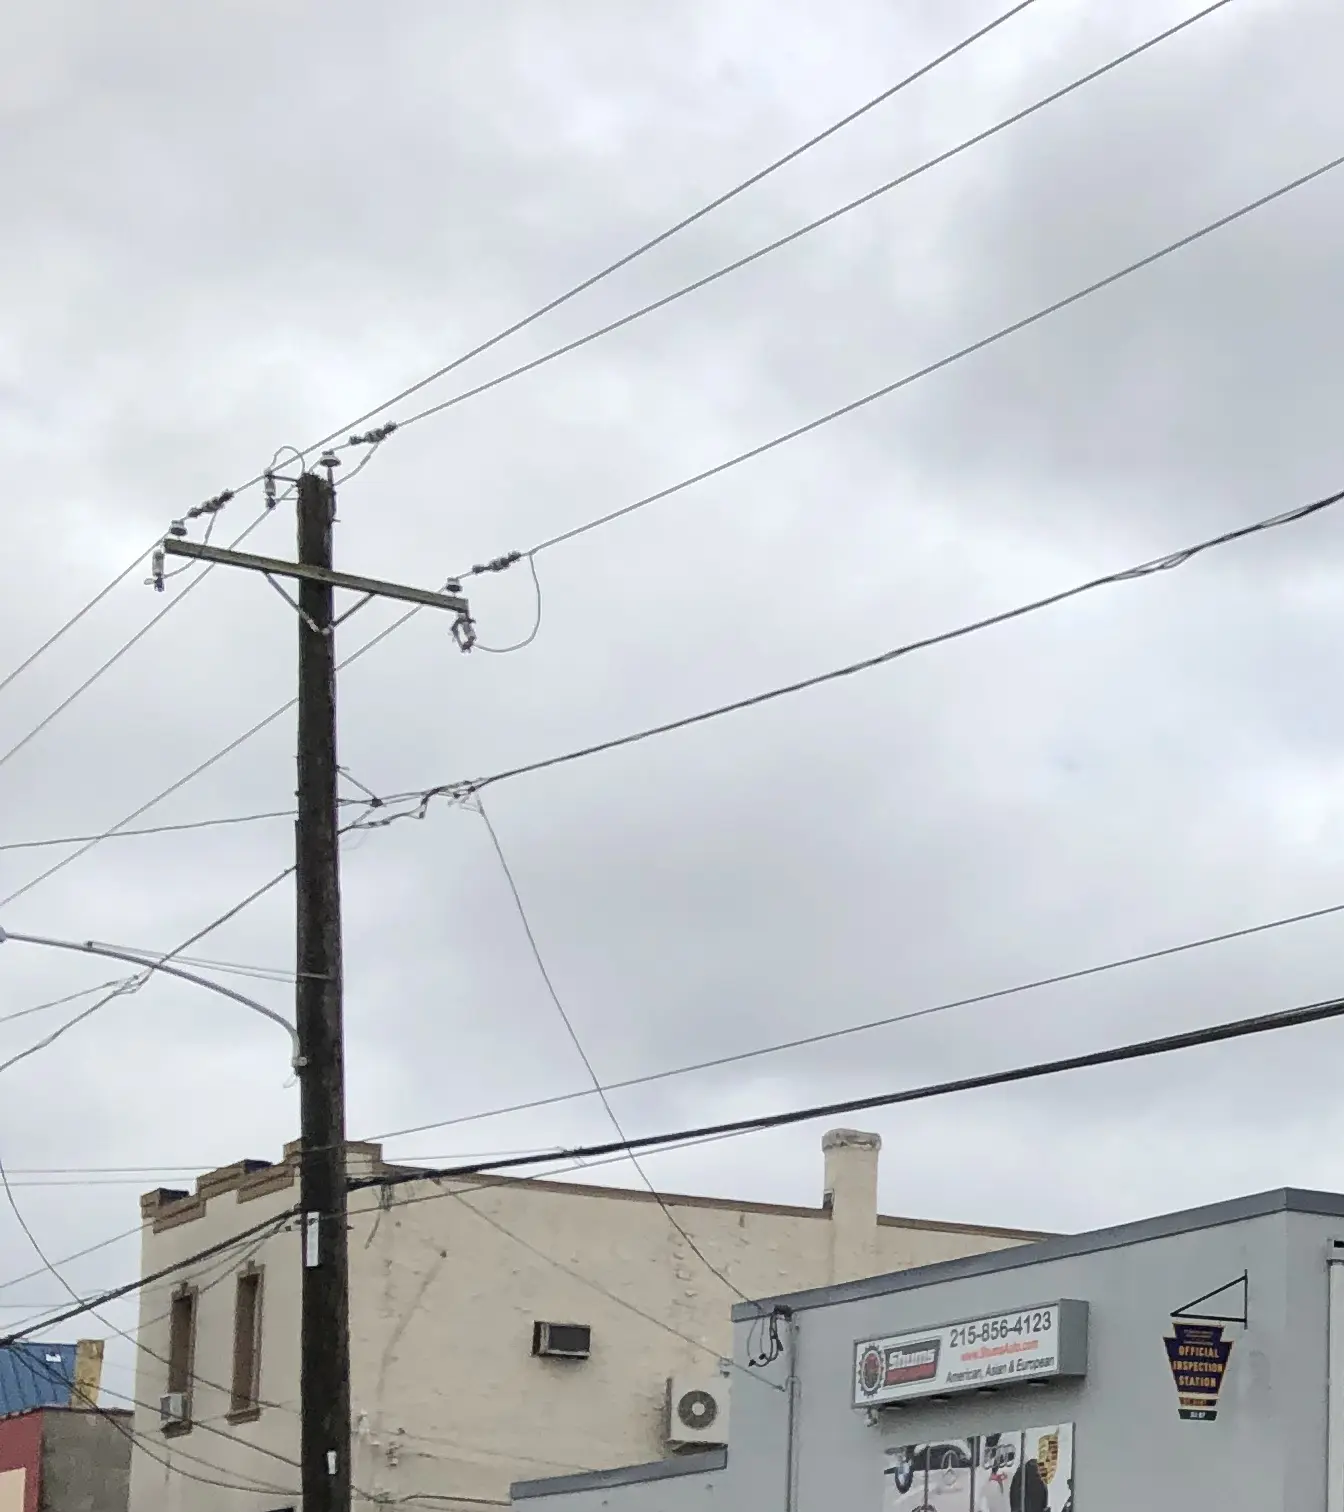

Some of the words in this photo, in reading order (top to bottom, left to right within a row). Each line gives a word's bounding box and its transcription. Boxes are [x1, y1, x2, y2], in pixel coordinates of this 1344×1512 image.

[949, 1311, 1052, 1348] 215-856-4123
[1178, 1345, 1220, 1358] OFFICIAL
[888, 1349, 936, 1370] Shums
[1016, 1356, 1055, 1373] European
[1172, 1360, 1223, 1372] INSPECTION
[1178, 1375, 1217, 1387] STATION
